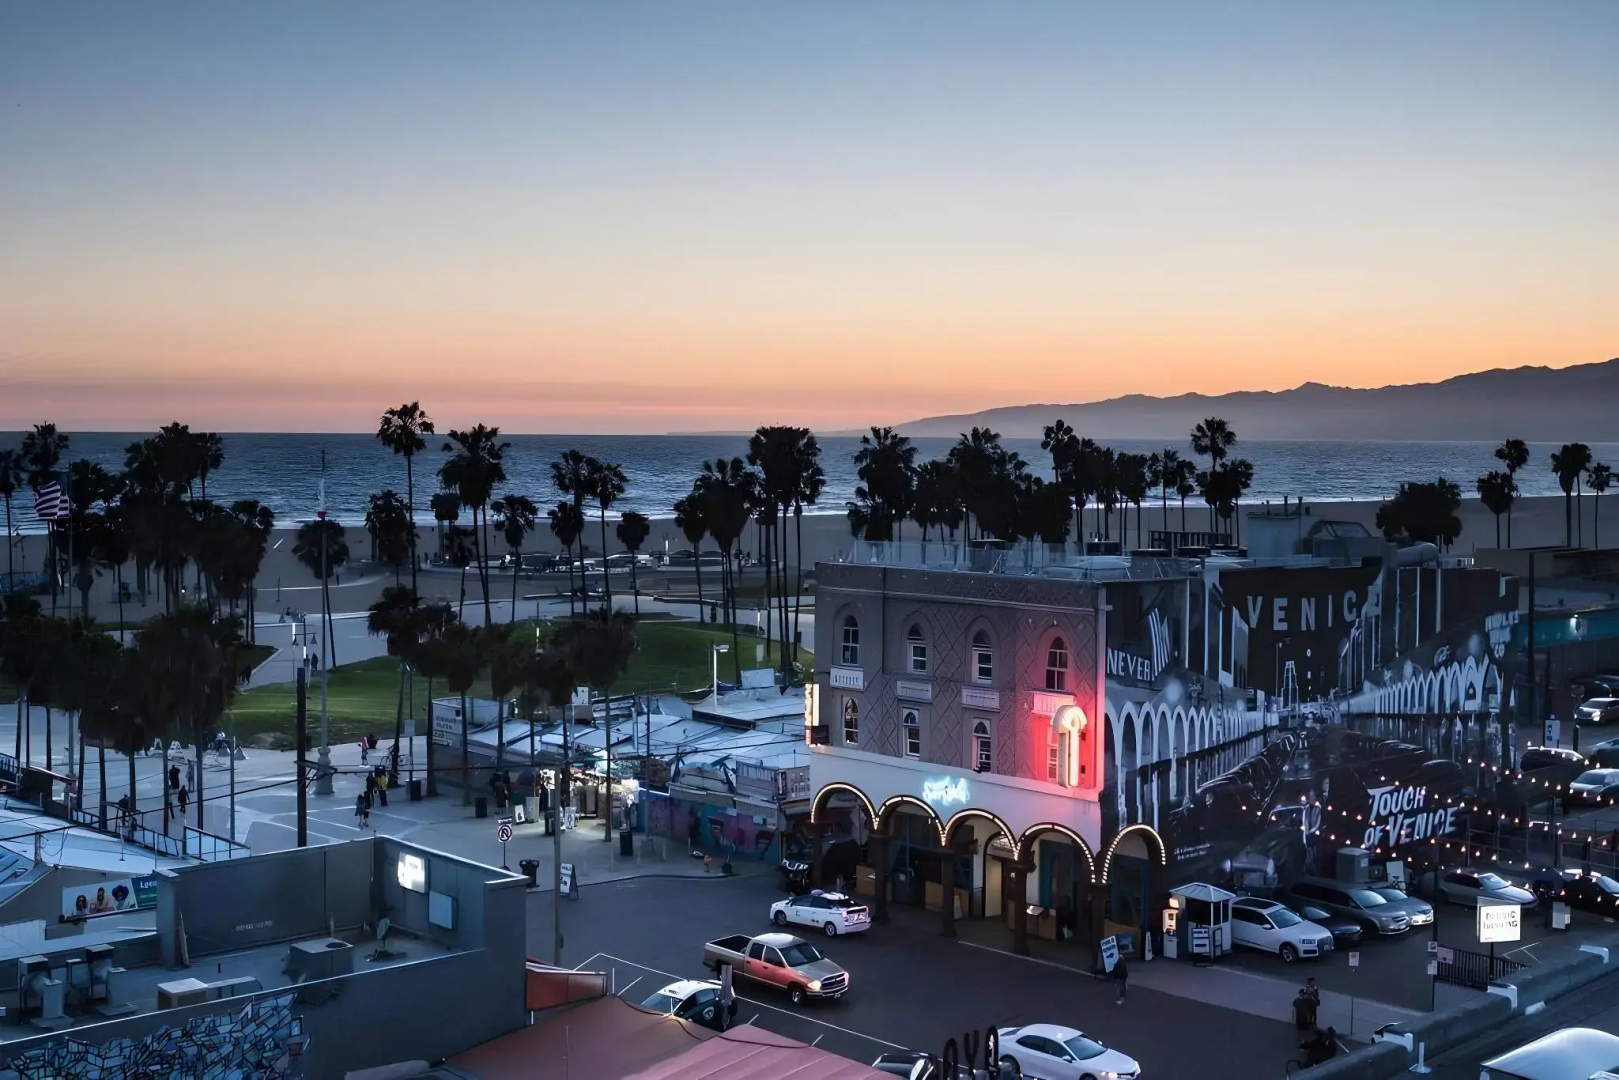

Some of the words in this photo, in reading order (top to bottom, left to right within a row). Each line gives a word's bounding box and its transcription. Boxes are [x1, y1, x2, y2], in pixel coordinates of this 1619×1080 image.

[1106, 646, 1151, 681] NEVER
[1366, 784, 1426, 824] TOUCH
[1364, 825, 1385, 849] OF
[1388, 806, 1458, 848] VENICE
